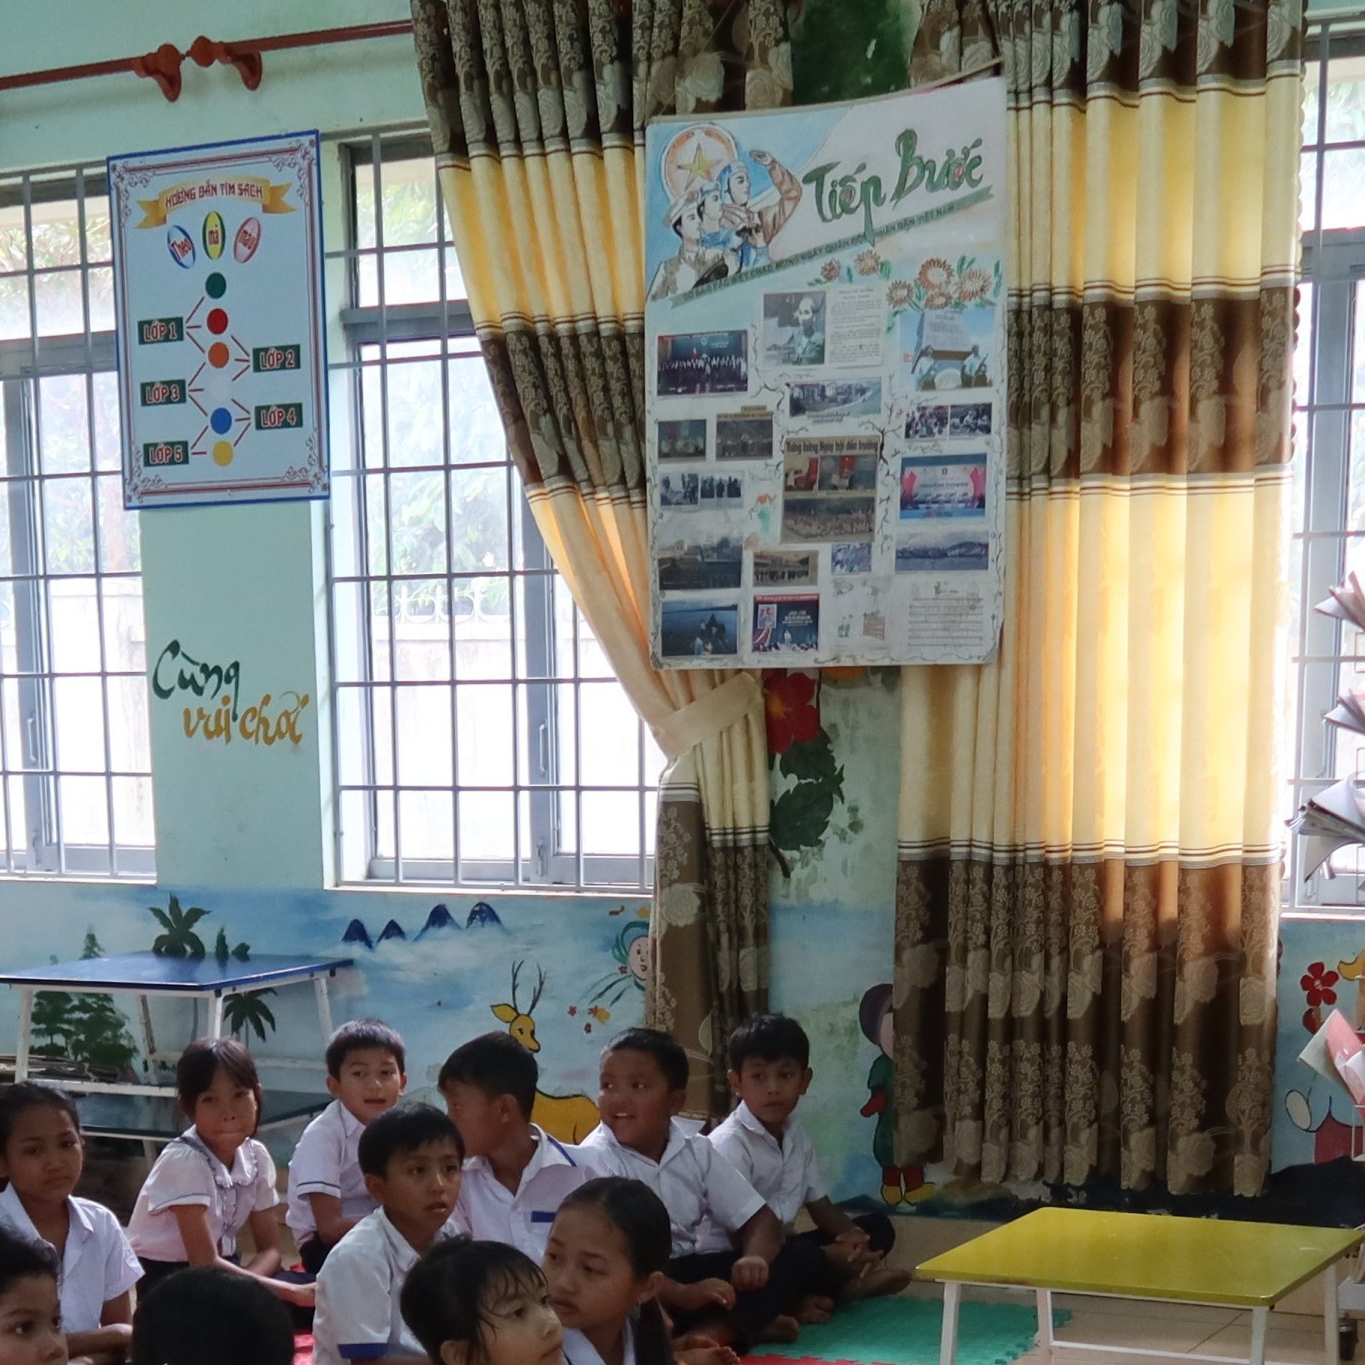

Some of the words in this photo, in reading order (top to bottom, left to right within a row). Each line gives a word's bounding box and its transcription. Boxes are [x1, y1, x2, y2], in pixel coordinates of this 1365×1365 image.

[802, 160, 886, 248] Tiếp
[143, 319, 166, 342] LỚP
[170, 321, 177, 339] 1
[260, 346, 283, 370] LỚP
[286, 350, 295, 368] 2
[146, 381, 168, 404] LỚP
[170, 386, 179, 402] 3
[260, 404, 284, 427] LỚP
[287, 408, 296, 425] 4
[149, 441, 172, 464] LỚP
[174, 445, 184, 462] 5
[152, 639, 240, 722] Cùng
[183, 694, 232, 745] vui
